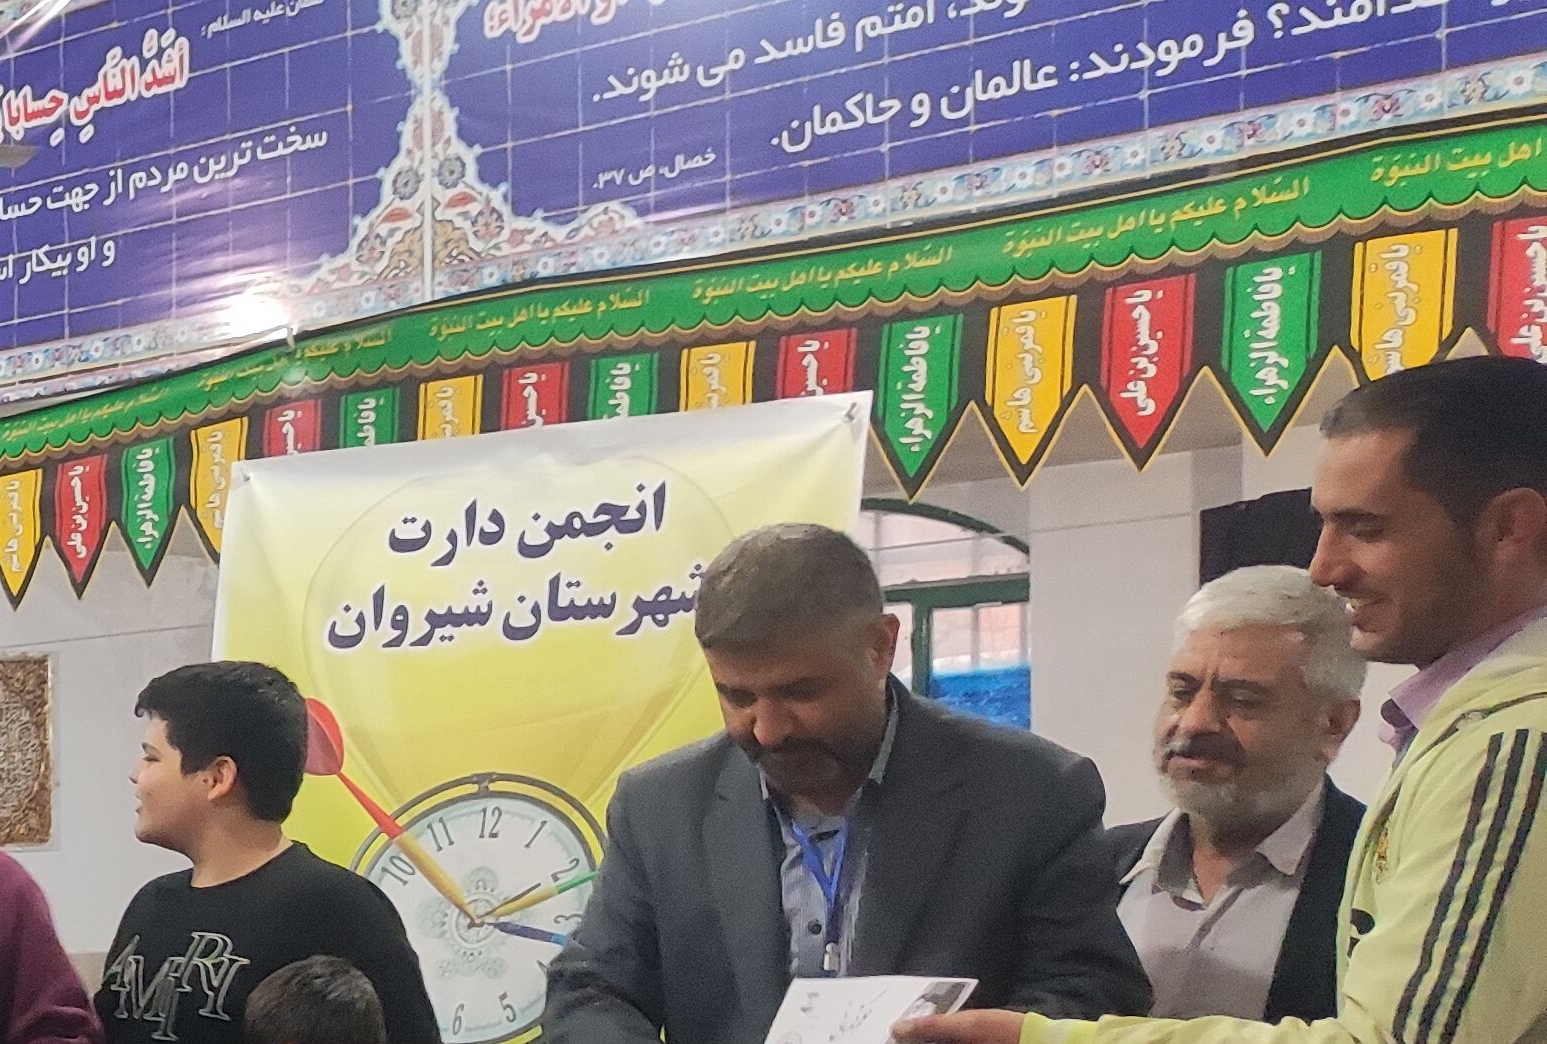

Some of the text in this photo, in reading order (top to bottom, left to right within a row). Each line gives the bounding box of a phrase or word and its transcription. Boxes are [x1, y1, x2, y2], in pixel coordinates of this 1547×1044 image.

[754, 13, 846, 65] فاسد
[1069, 12, 1256, 83] فرمودند:
[592, 54, 690, 103] شوند.
[697, 45, 746, 88] می
[940, 60, 1059, 119] عالمان
[771, 94, 902, 154] حاکمان.
[910, 94, 931, 127] و
[255, 125, 329, 161] سخت
[104, 168, 124, 204] از
[129, 161, 189, 192] مردم
[193, 141, 252, 198] ترین
[628, 163, 656, 186] ص
[45, 178, 100, 212] جهت
[19, 247, 71, 284] بیکار
[77, 236, 98, 273] او
[102, 240, 116, 265] و
[388, 480, 667, 568] انجمن دارت
[326, 579, 494, 649] شیروان
[426, 816, 456, 852] 11
[478, 806, 503, 840] 12
[524, 819, 548, 849] 1
[381, 854, 416, 887] 10
[551, 857, 580, 883] 2
[451, 1003, 465, 1036] 6
[498, 992, 517, 1023] 5
